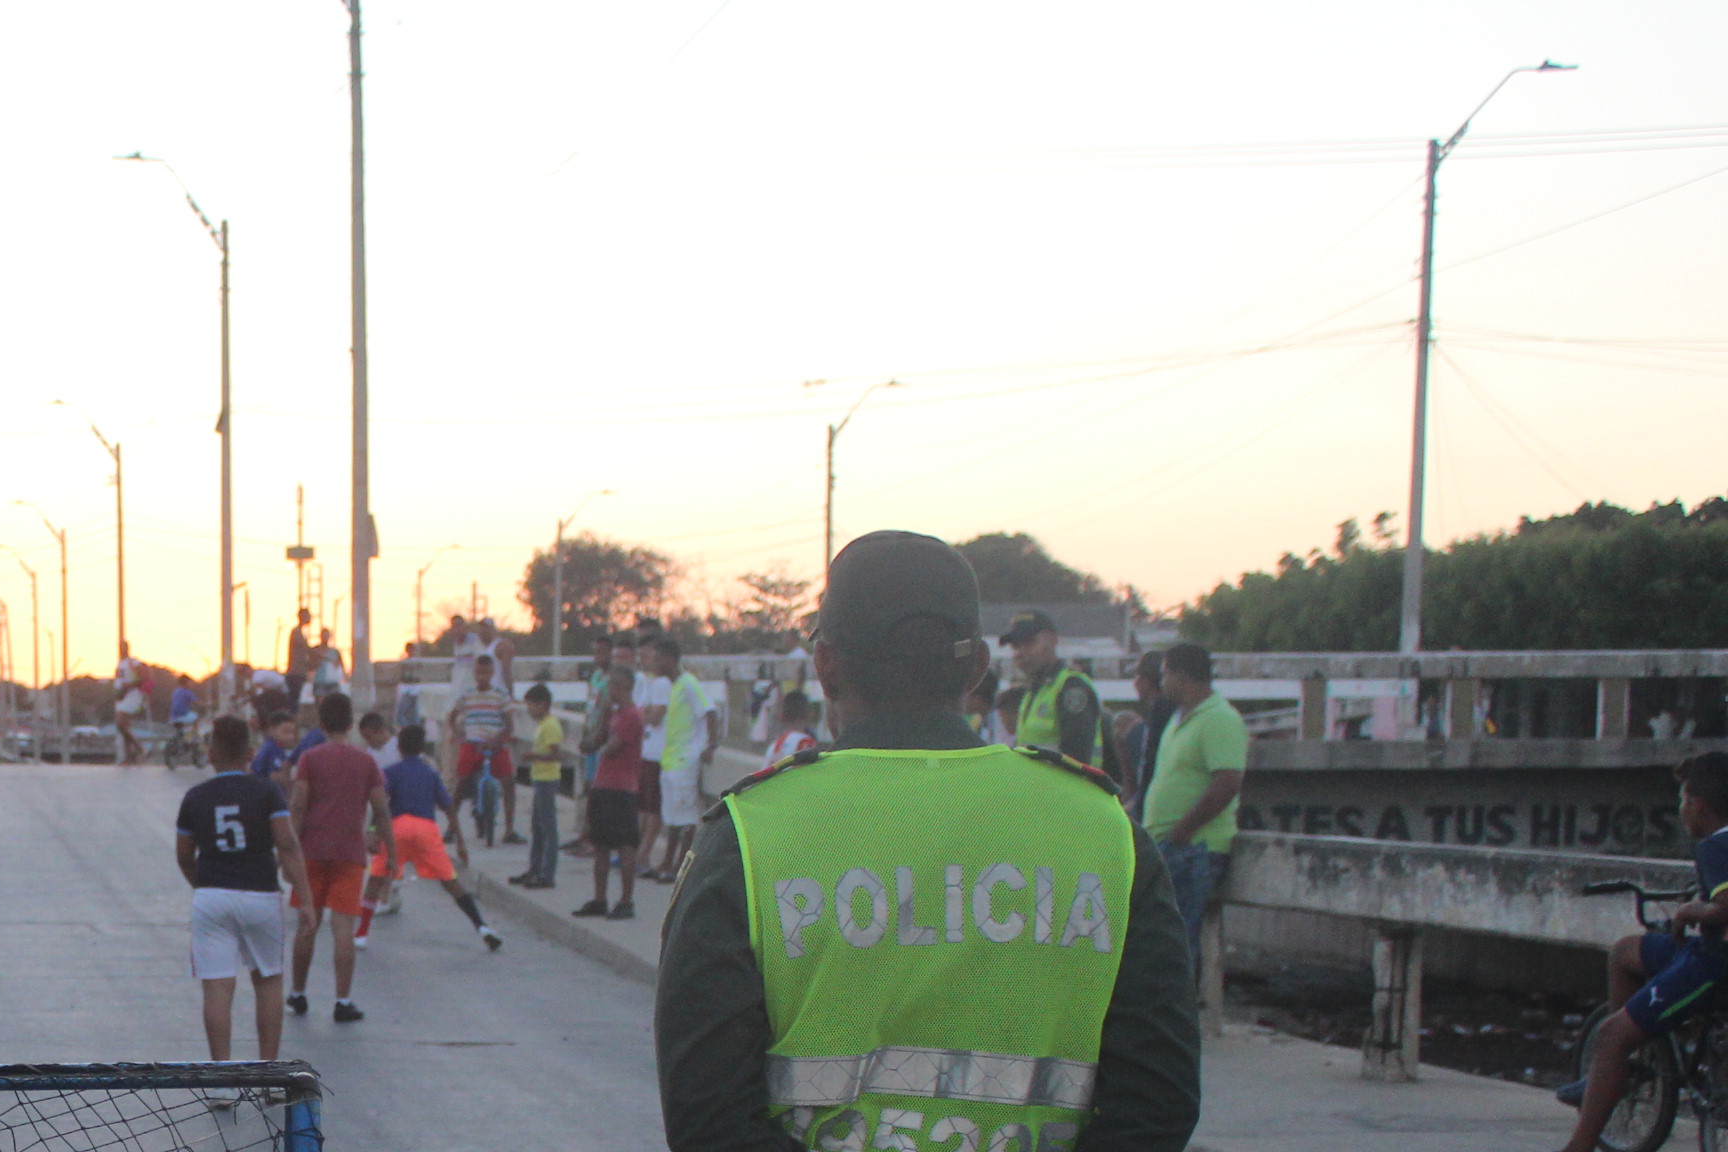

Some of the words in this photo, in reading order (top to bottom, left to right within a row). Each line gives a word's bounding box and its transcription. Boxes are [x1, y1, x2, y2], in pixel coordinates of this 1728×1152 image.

[214, 805, 247, 853] 5
[1425, 804, 1516, 846] TUS
[774, 862, 1114, 960] POLICIA
